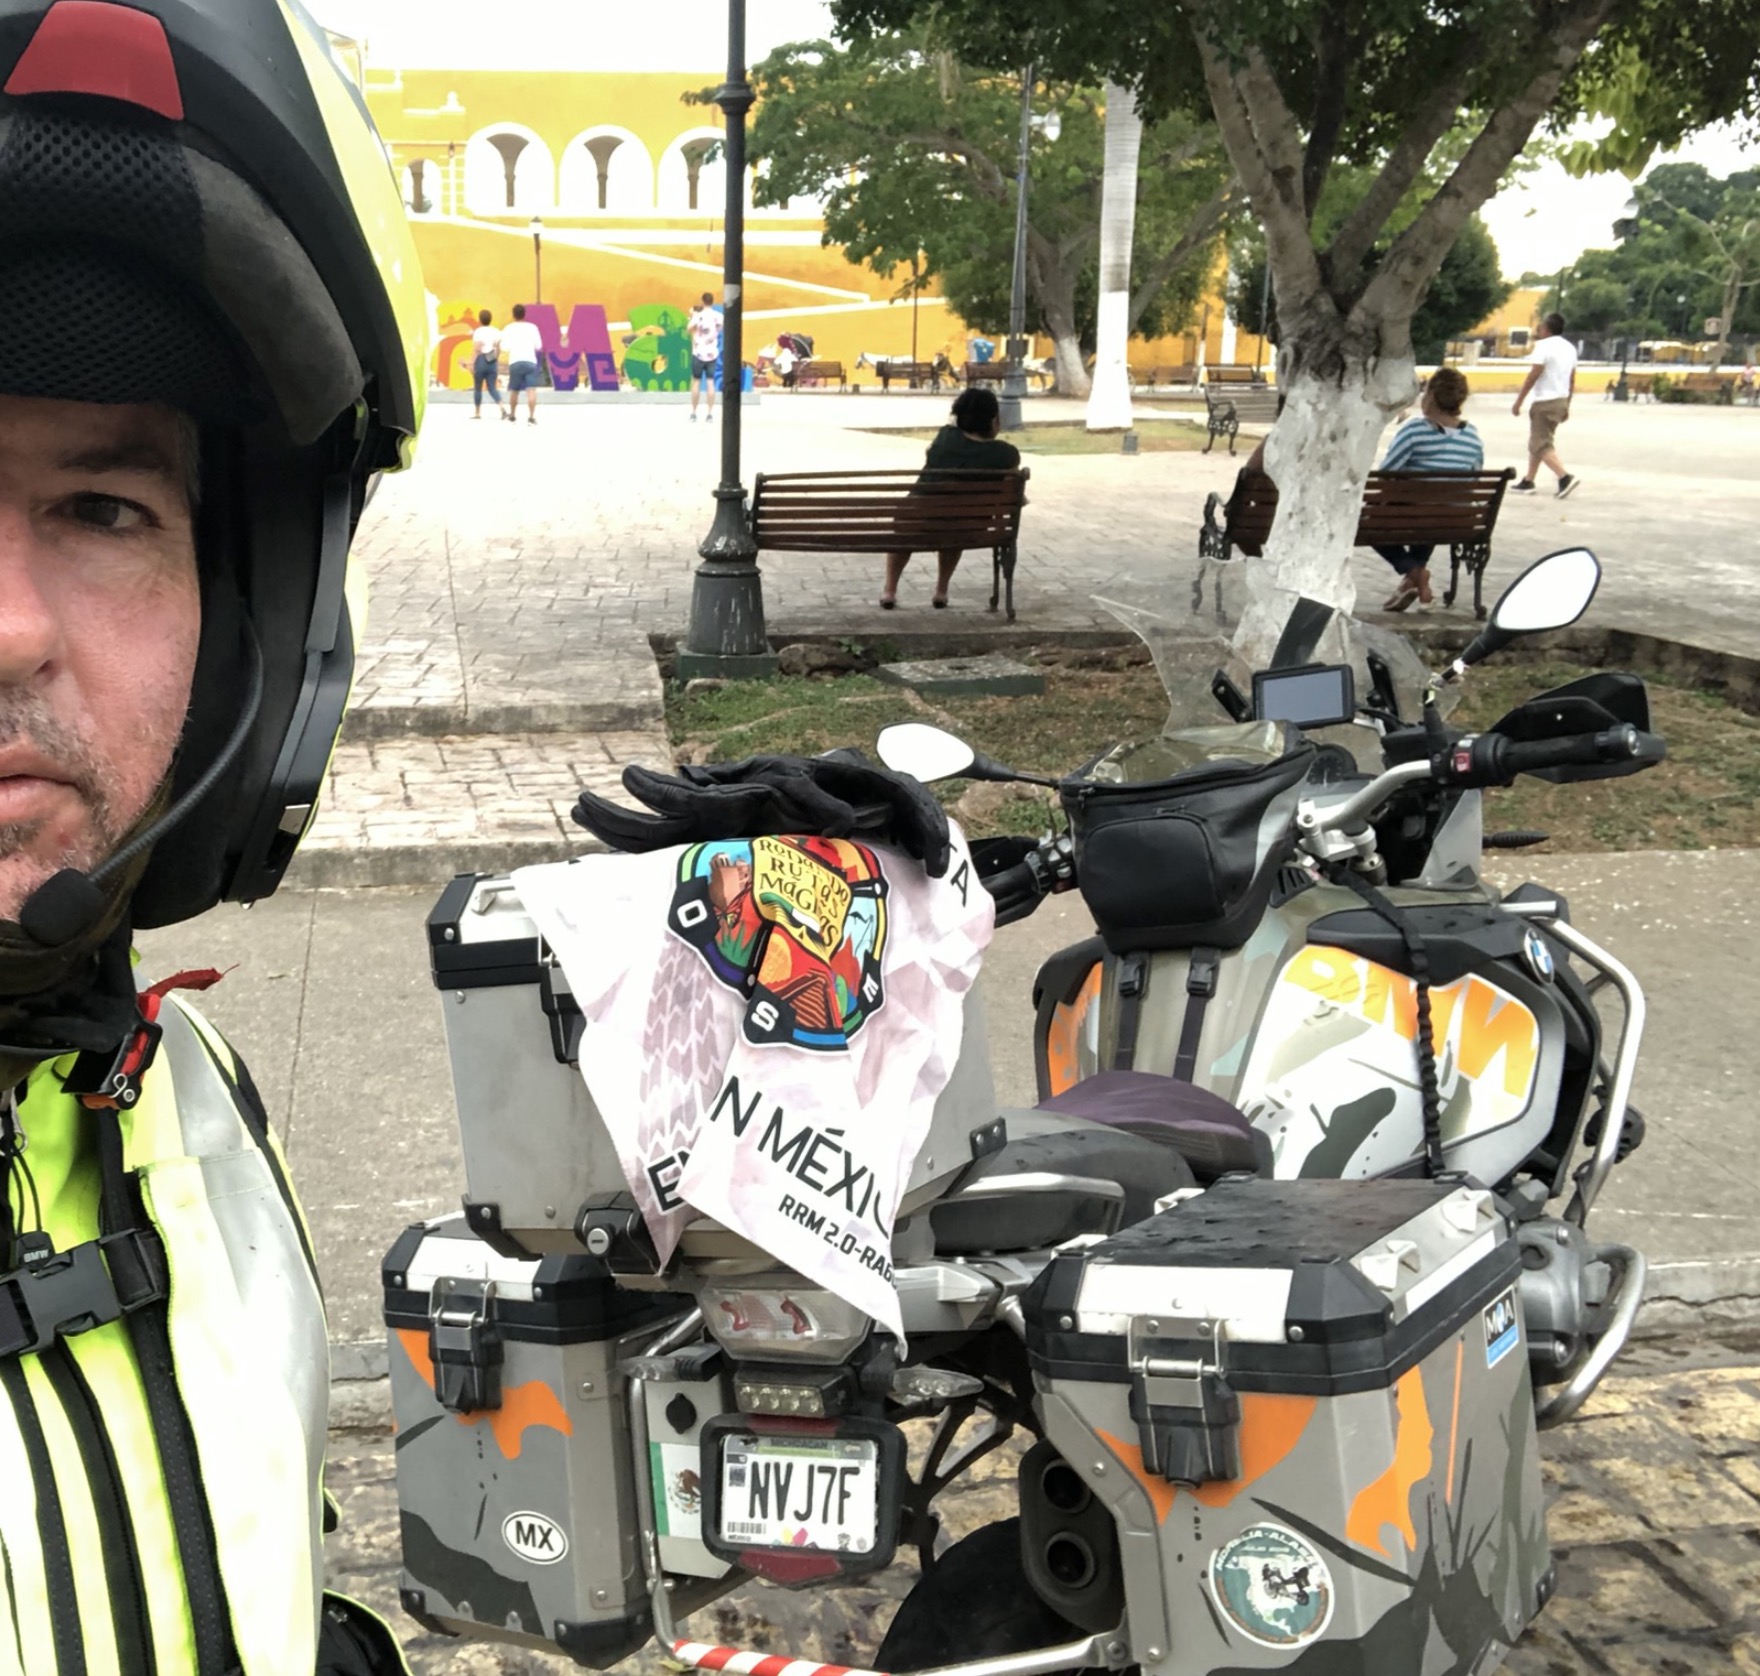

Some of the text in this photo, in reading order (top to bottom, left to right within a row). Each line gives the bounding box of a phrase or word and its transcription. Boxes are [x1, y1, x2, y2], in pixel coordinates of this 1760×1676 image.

[751, 1001, 779, 1032] S
[777, 1193, 826, 1236] RRM
[23, 1249, 49, 1263] BMW
[748, 1461, 861, 1526] NVJ7F
[515, 1520, 554, 1552] MX
